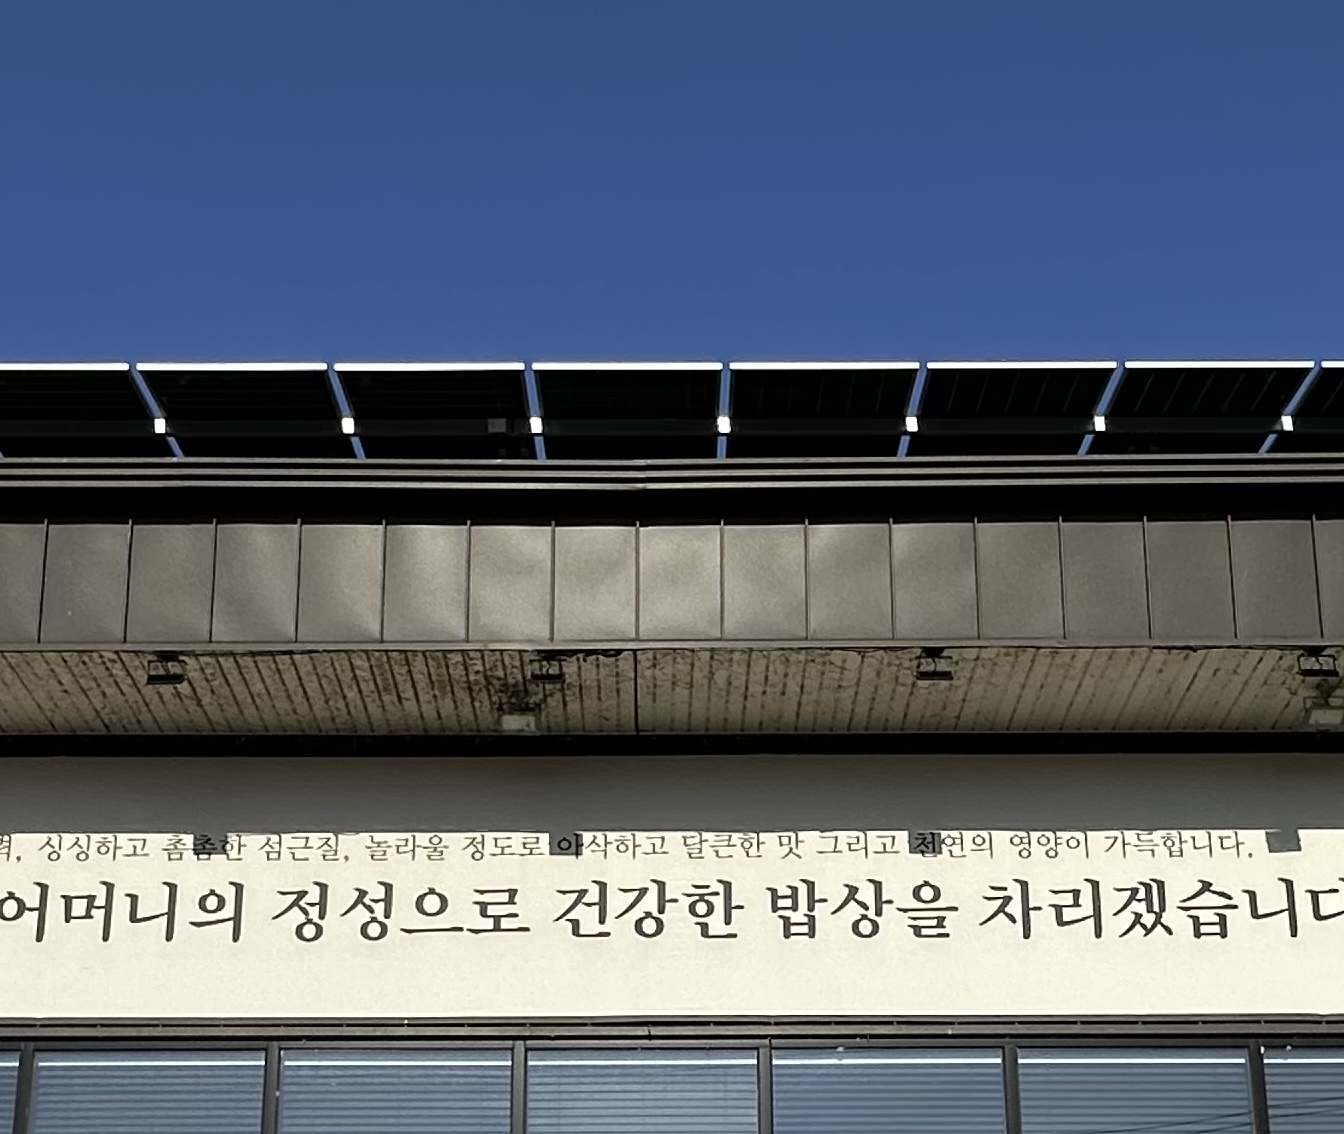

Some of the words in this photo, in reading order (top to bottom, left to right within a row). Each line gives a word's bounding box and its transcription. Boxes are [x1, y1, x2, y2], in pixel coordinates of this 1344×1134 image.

[38, 834, 150, 862] 싱싱하고
[161, 834, 247, 862] 촘촘한
[257, 834, 350, 862] 섬근질,
[365, 833, 450, 861] 놀라울
[462, 833, 547, 861] 정도로
[556, 833, 670, 861] 아삭하고
[682, 833, 765, 861] 달큰한
[779, 832, 804, 860] 맛
[817, 832, 900, 860] 그리고
[913, 832, 994, 860] 천연의
[1010, 832, 1090, 860] 영양이
[1105, 831, 1254, 859] 가득합니다.
[271, 880, 531, 941] 정성으로
[553, 879, 745, 940] 건강한
[765, 879, 959, 940] 밥상을
